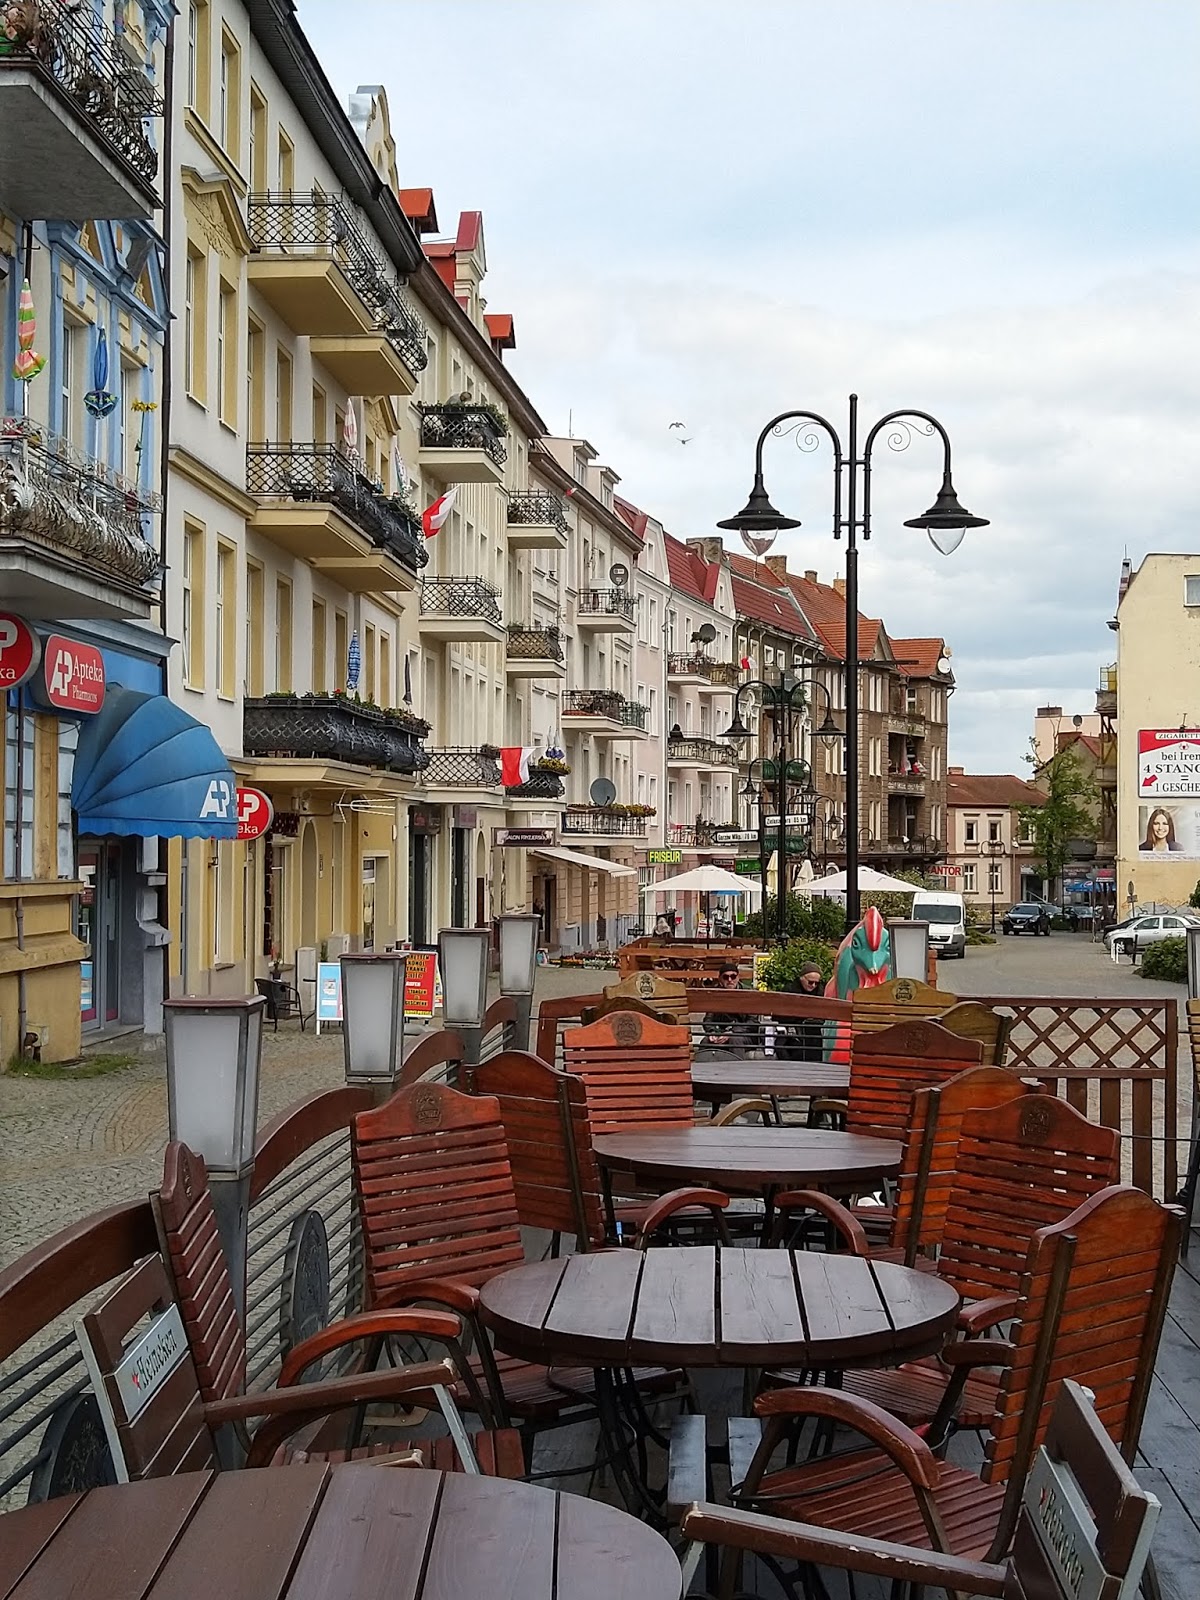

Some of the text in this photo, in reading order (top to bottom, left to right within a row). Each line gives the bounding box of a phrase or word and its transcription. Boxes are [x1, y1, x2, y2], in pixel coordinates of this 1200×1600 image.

[0, 620, 18, 661] P
[49, 649, 73, 697] AP
[72, 655, 103, 685] Apteka
[1161, 752, 1200, 761] bei Iren
[1143, 764, 1151, 774] 4
[1155, 783, 1200, 792] 1 GESCHE
[199, 780, 230, 818] AP
[649, 851, 680, 863] FRISEUR
